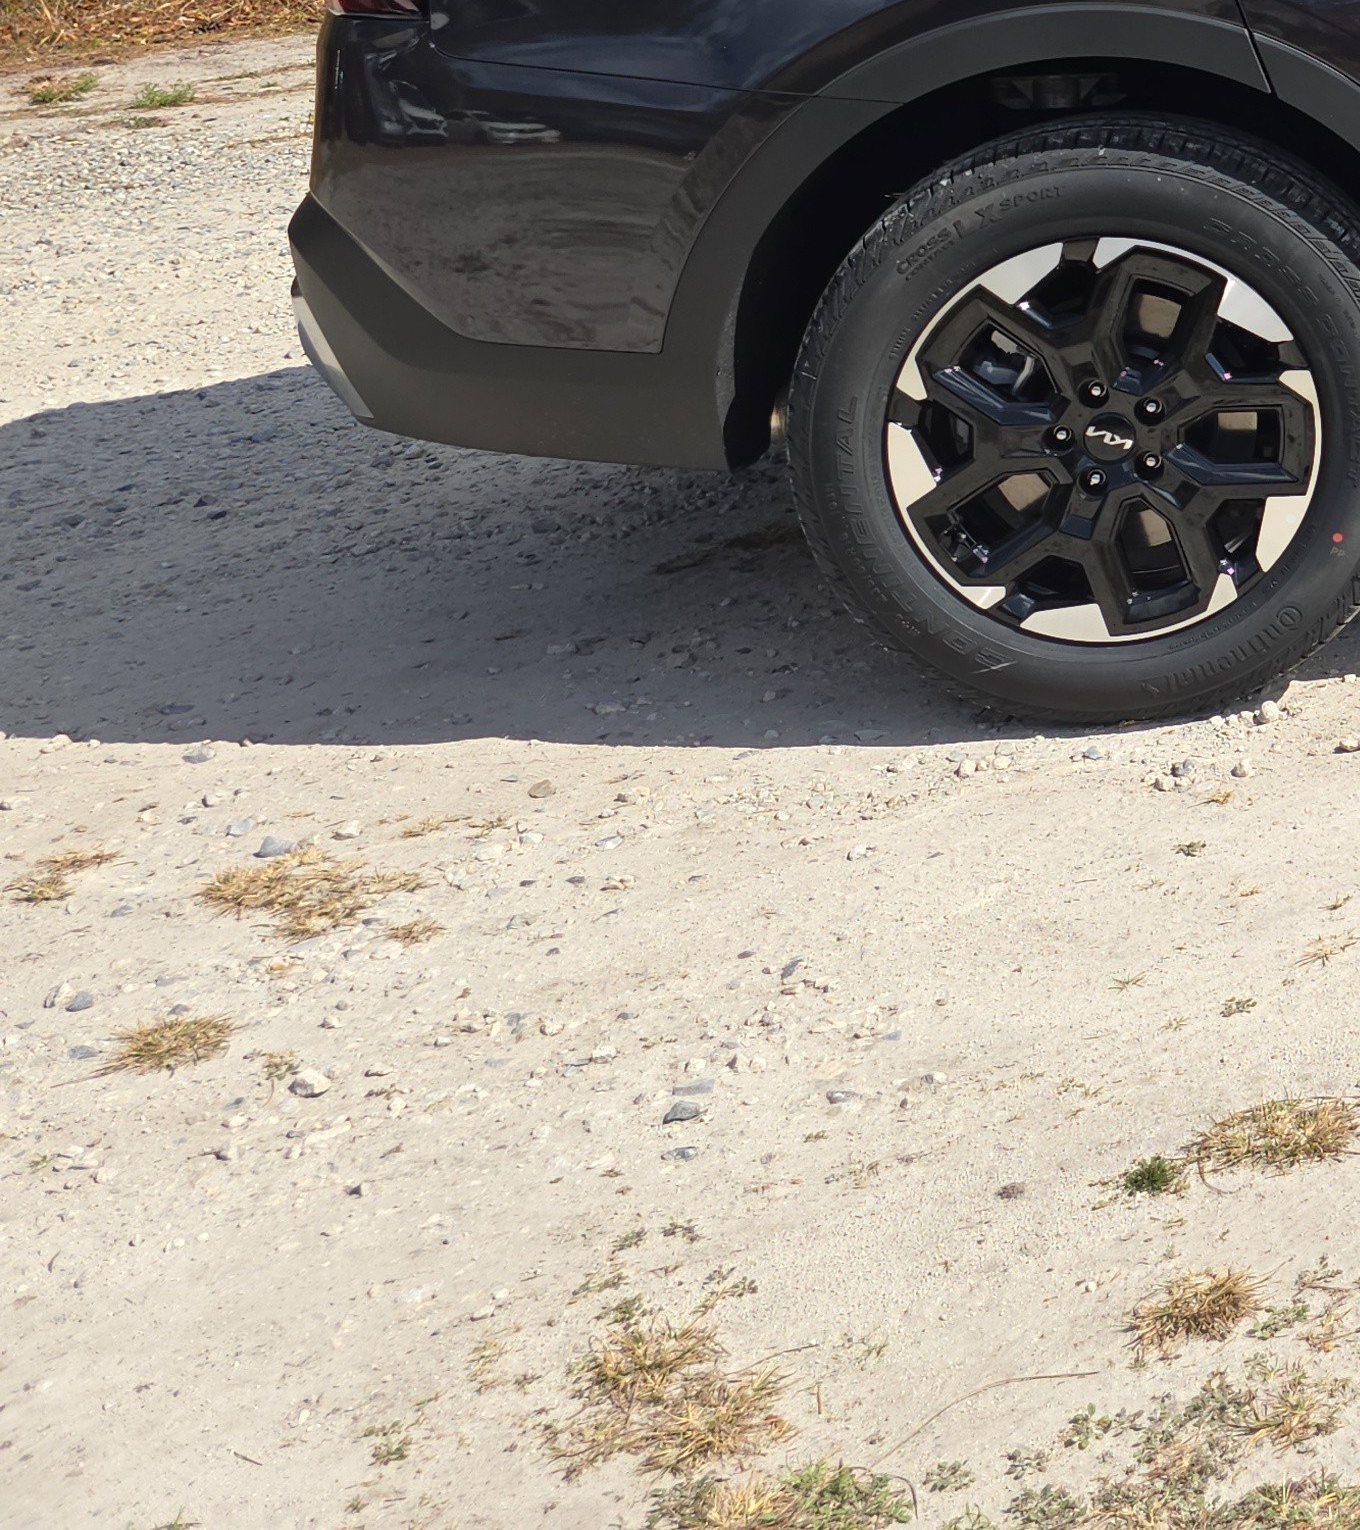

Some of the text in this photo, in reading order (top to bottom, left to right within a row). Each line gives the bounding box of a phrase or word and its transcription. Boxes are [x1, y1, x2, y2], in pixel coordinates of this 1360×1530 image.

[897, 227, 951, 275] CROSS
[999, 184, 1062, 212] SPORT
[1085, 425, 1133, 450] KIA
[836, 396, 1013, 670] CONTINENTAL
